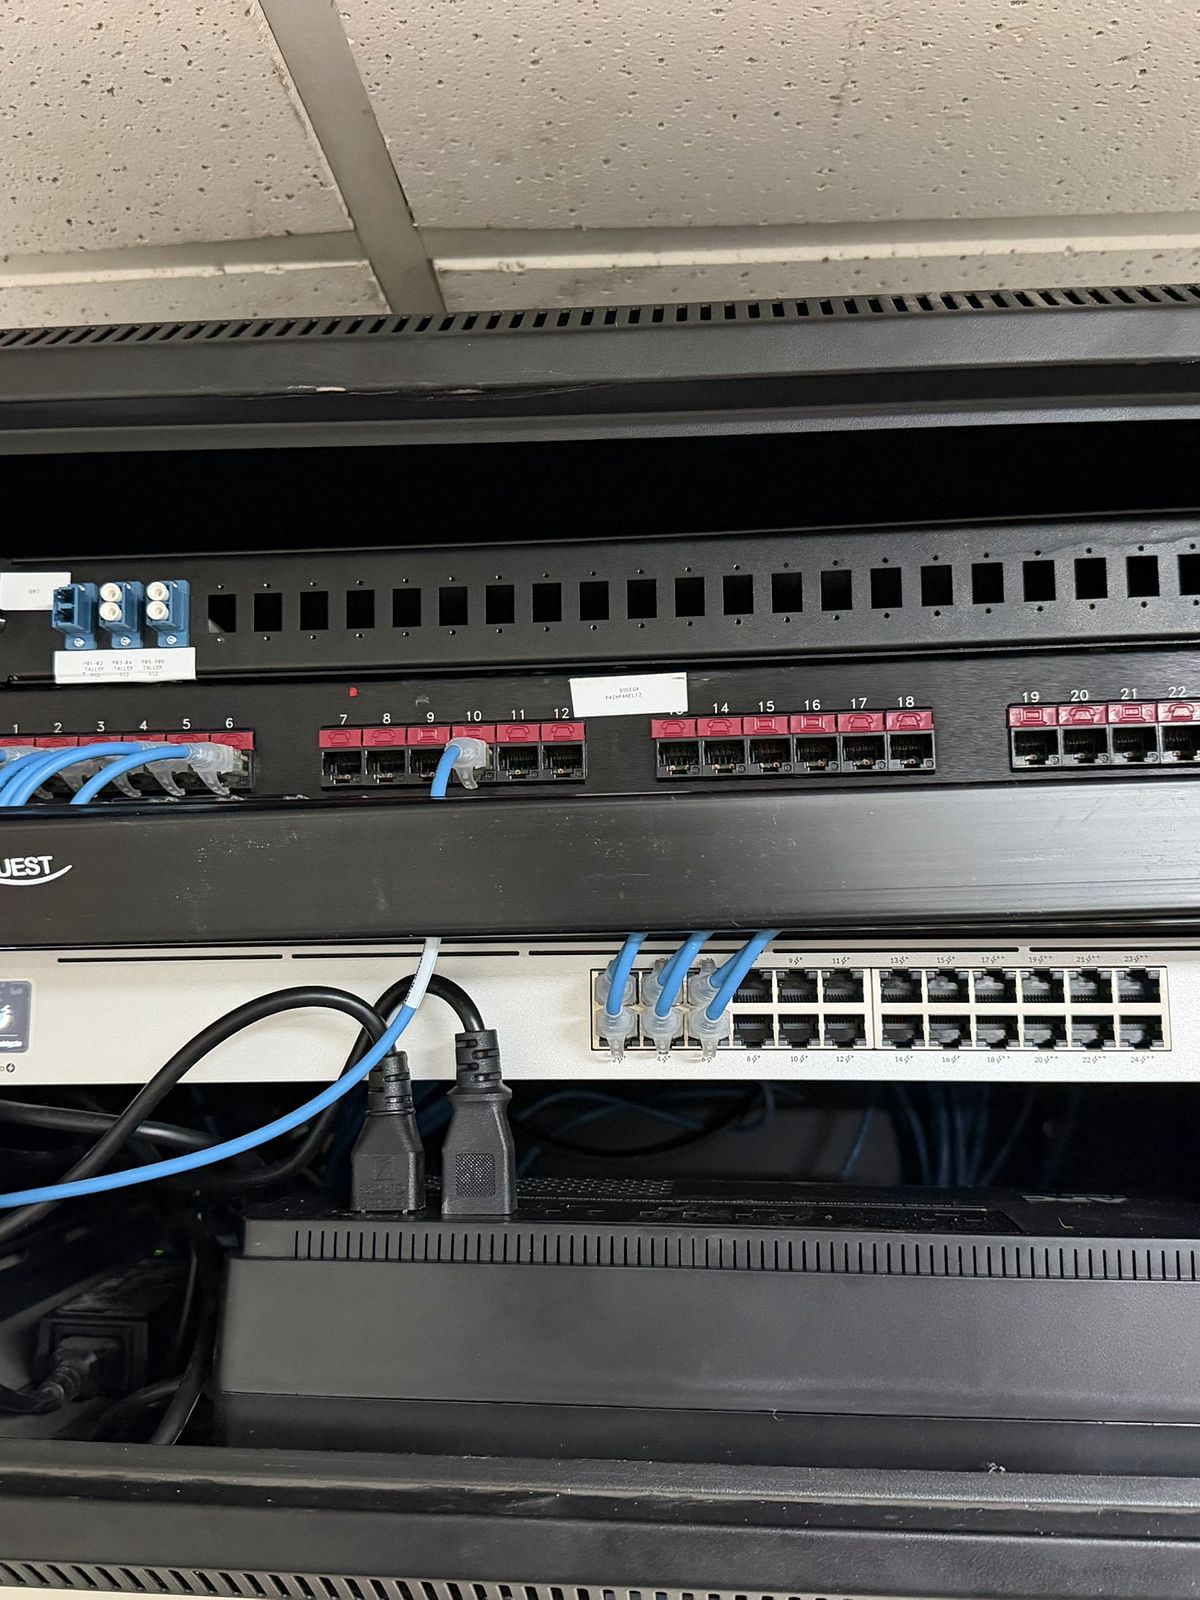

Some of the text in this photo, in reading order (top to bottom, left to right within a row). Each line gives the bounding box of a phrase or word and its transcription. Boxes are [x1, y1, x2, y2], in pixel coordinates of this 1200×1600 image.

[1022, 685, 1188, 703] 19 20 21 22
[712, 695, 915, 714] 14 15 16 17 18
[339, 707, 570, 725] 7 8 9 10 11 12
[13, 717, 234, 734] 1 2 3 4 5 6
